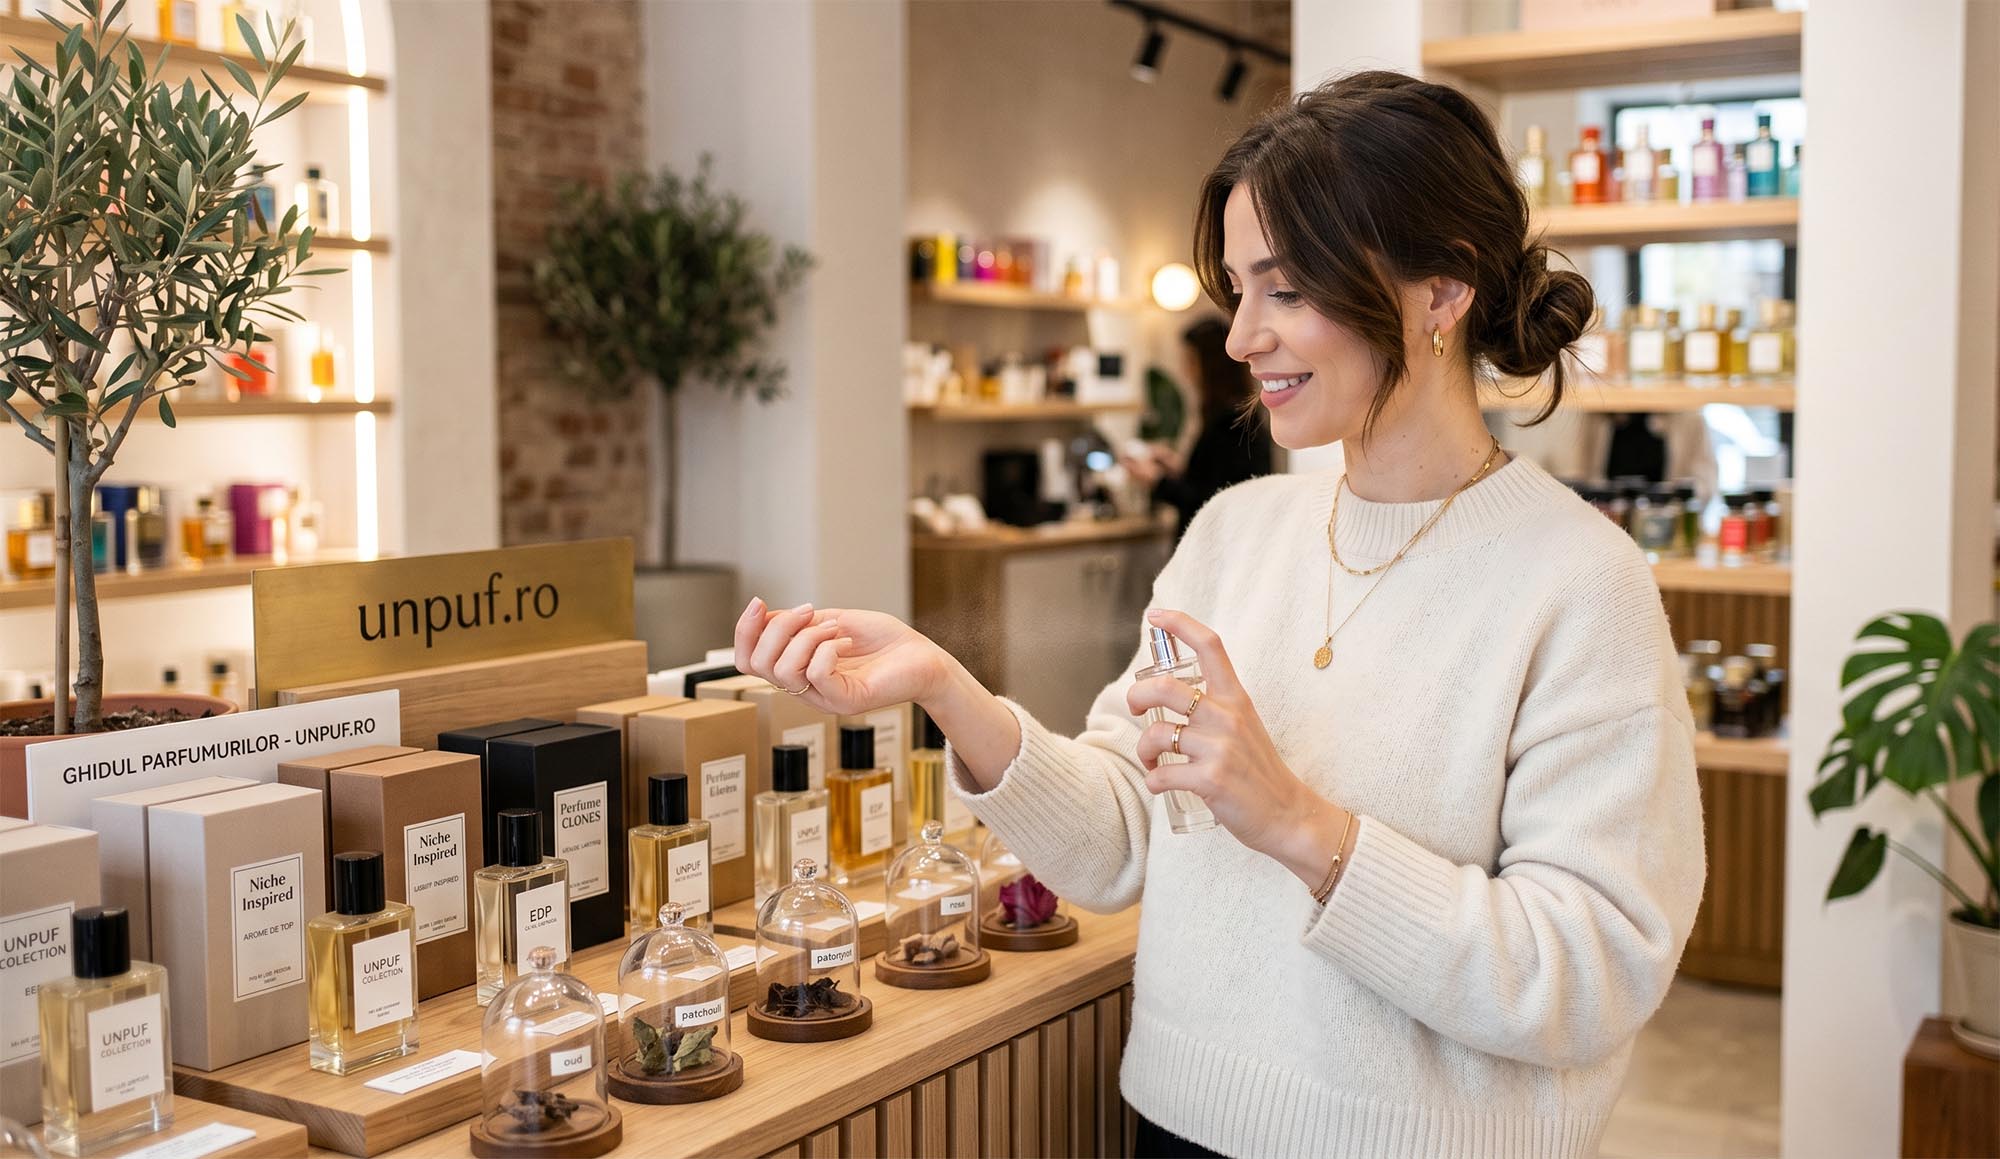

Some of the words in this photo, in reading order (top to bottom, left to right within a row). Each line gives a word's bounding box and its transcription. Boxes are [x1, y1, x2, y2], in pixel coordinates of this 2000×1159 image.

[358, 572, 559, 648] unpuf.ro
[63, 758, 137, 785] GHIDUL
[142, 733, 280, 772] PARFUMURILOR
[295, 717, 376, 746] UNPUF.RO
[560, 799, 601, 815] Perfume
[561, 811, 601, 829] CLONES
[420, 832, 451, 848] Niche
[413, 844, 457, 866] Inspired
[675, 860, 701, 876] UNPUF
[250, 873, 286, 893] Niche
[242, 886, 293, 911] Inspired
[530, 905, 552, 922] EDP
[4, 927, 60, 953] UNPUF
[243, 928, 268, 941] AROME
[269, 926, 279, 935] DE
[280, 921, 294, 931] TOP
[0, 943, 67, 970] COLECTION
[363, 954, 401, 974] UNPUF
[362, 967, 403, 985] COLLECTION
[682, 1004, 722, 1021] patchouli
[102, 1022, 149, 1047] UNPUF
[100, 1037, 152, 1058] COLLECTION
[563, 1054, 583, 1067] oud
